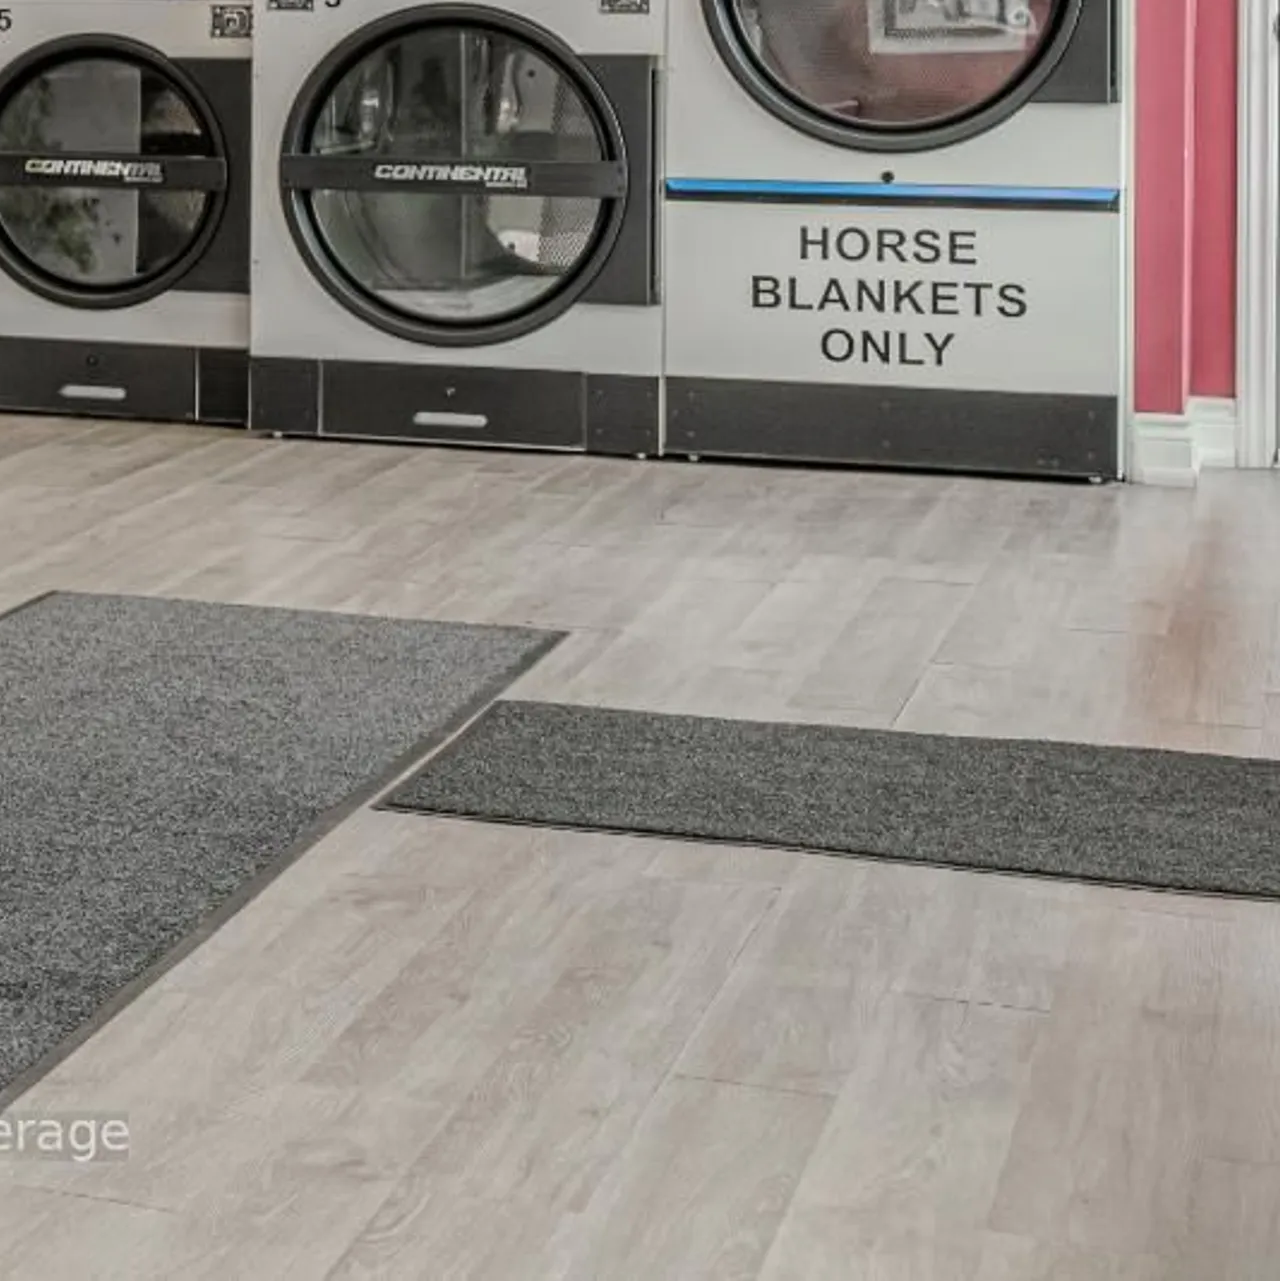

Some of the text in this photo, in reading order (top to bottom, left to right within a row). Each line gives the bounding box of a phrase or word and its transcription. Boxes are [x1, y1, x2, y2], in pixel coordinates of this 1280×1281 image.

[24, 159, 162, 178] CONTINENTAL
[374, 164, 527, 182] CONTINENTAL
[799, 225, 978, 266] HORSE
[751, 274, 1028, 319] BLANKETS
[820, 327, 956, 367] ONLY
